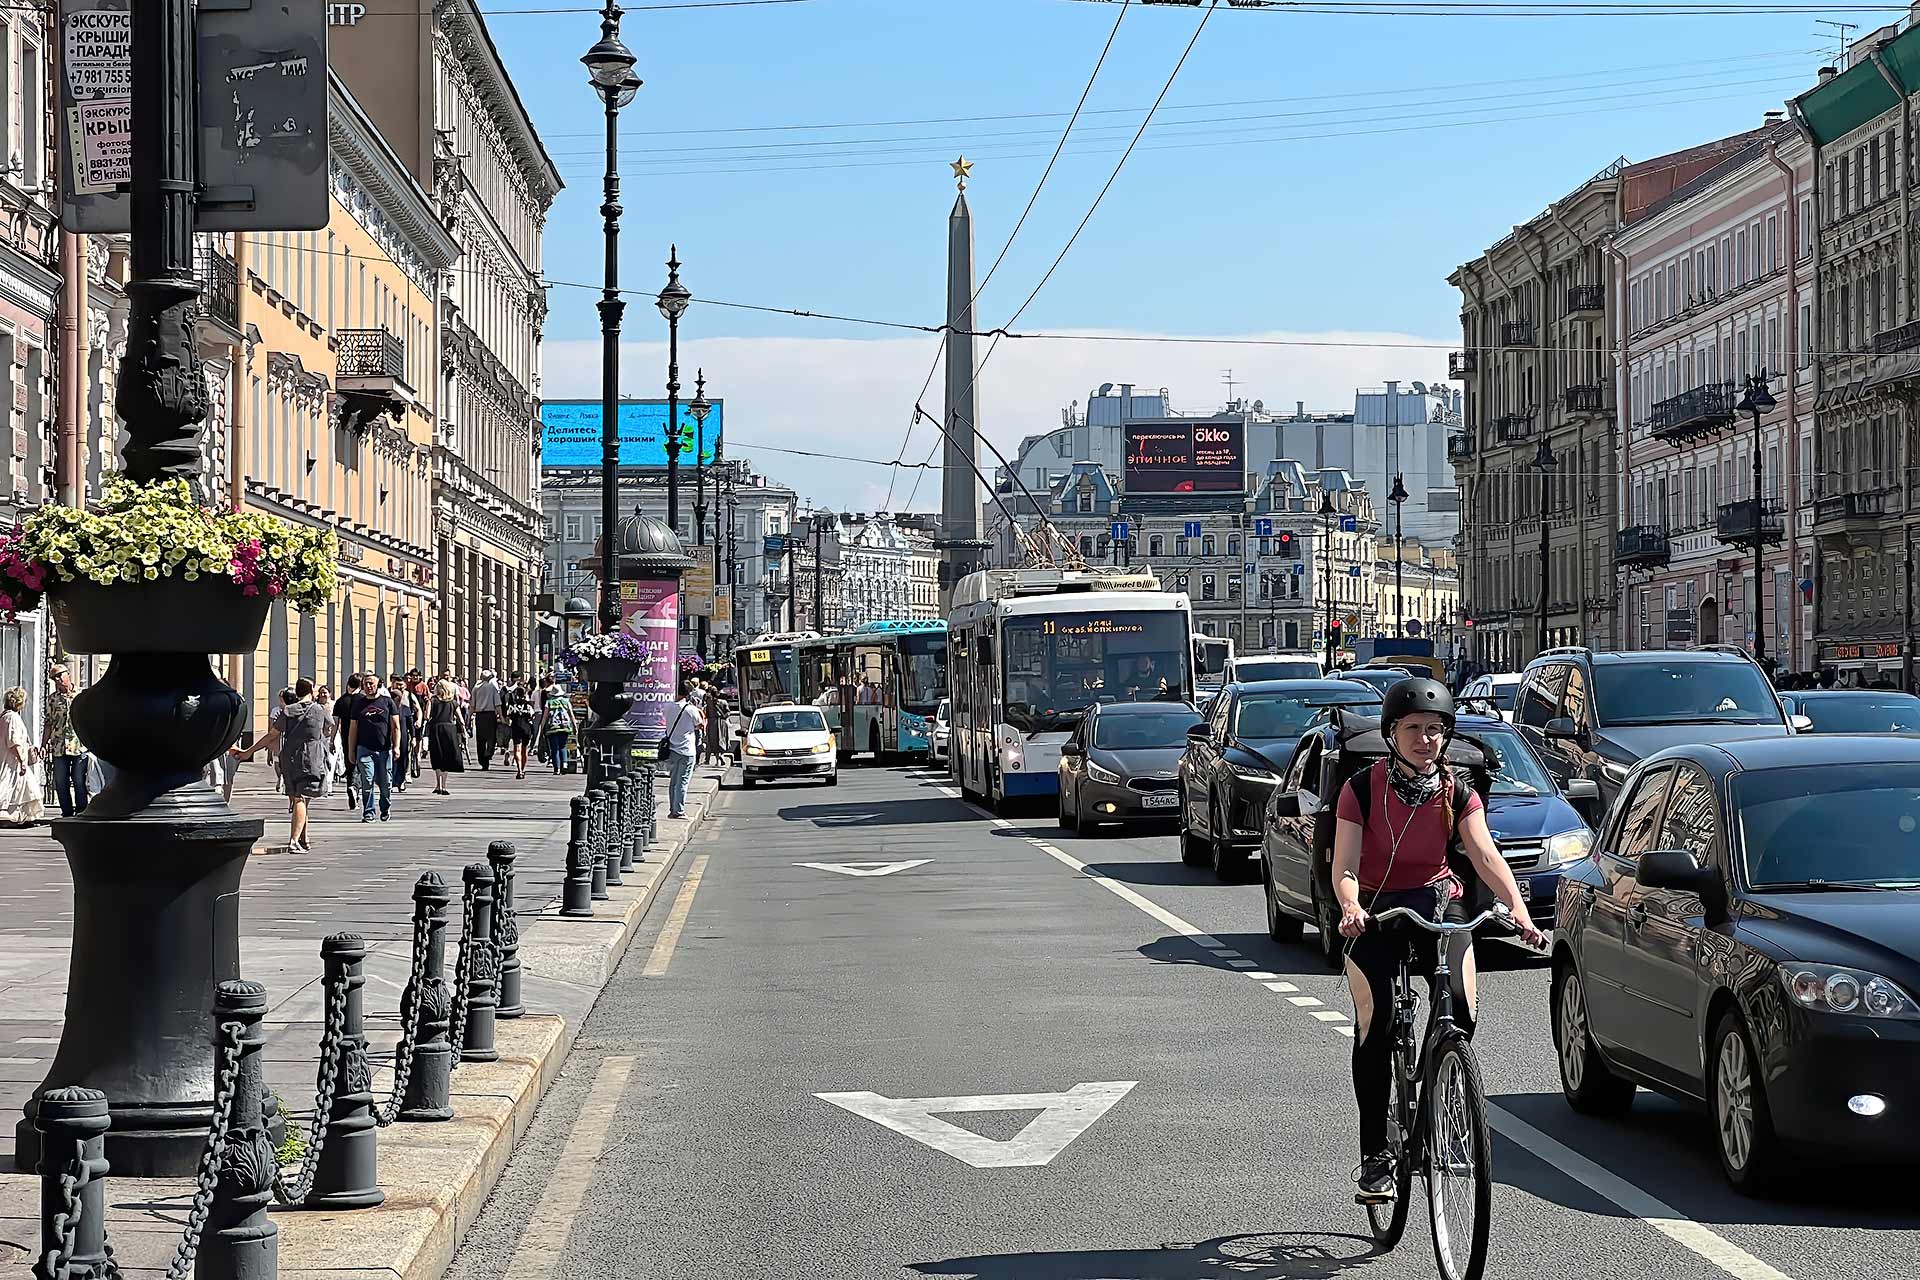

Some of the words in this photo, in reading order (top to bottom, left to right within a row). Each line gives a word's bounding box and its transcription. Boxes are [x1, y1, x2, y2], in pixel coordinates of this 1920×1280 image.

[70, 14, 130, 28] ЭКСКУРС
[76, 31, 129, 43] КРЫШИ
[76, 45, 131, 59] ПАРАДН
[70, 70, 82, 83] +7
[84, 70, 102, 83] 981
[105, 70, 123, 83] 755
[84, 107, 130, 118] ЭКСКУРС
[547, 426, 597, 434] Делитесь
[547, 436, 596, 444] хорошим
[1043, 621, 1055, 635] 11
